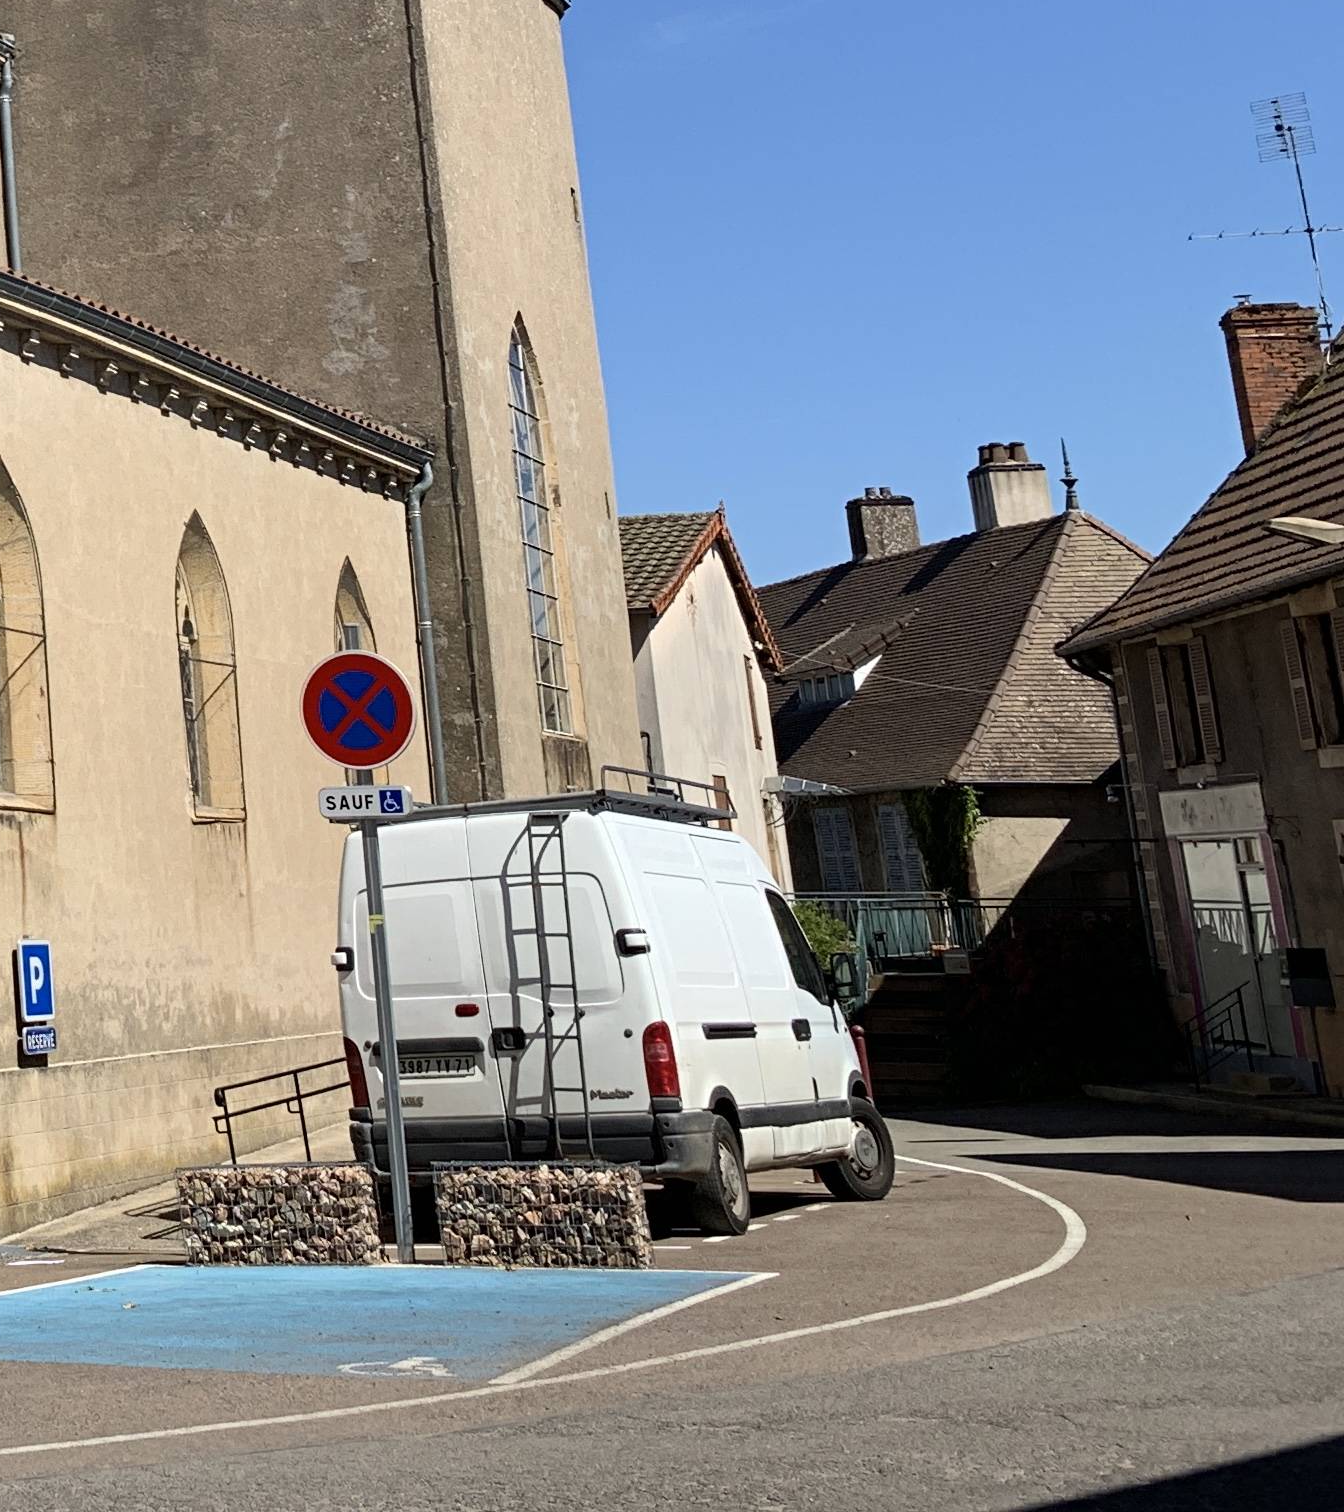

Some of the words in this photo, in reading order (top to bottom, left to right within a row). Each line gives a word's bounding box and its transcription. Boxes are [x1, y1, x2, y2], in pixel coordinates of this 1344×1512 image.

[325, 794, 374, 811] SAUF
[29, 956, 45, 1004] P
[27, 1030, 55, 1050] RÉSERVÉ
[399, 1059, 431, 1074] 3987
